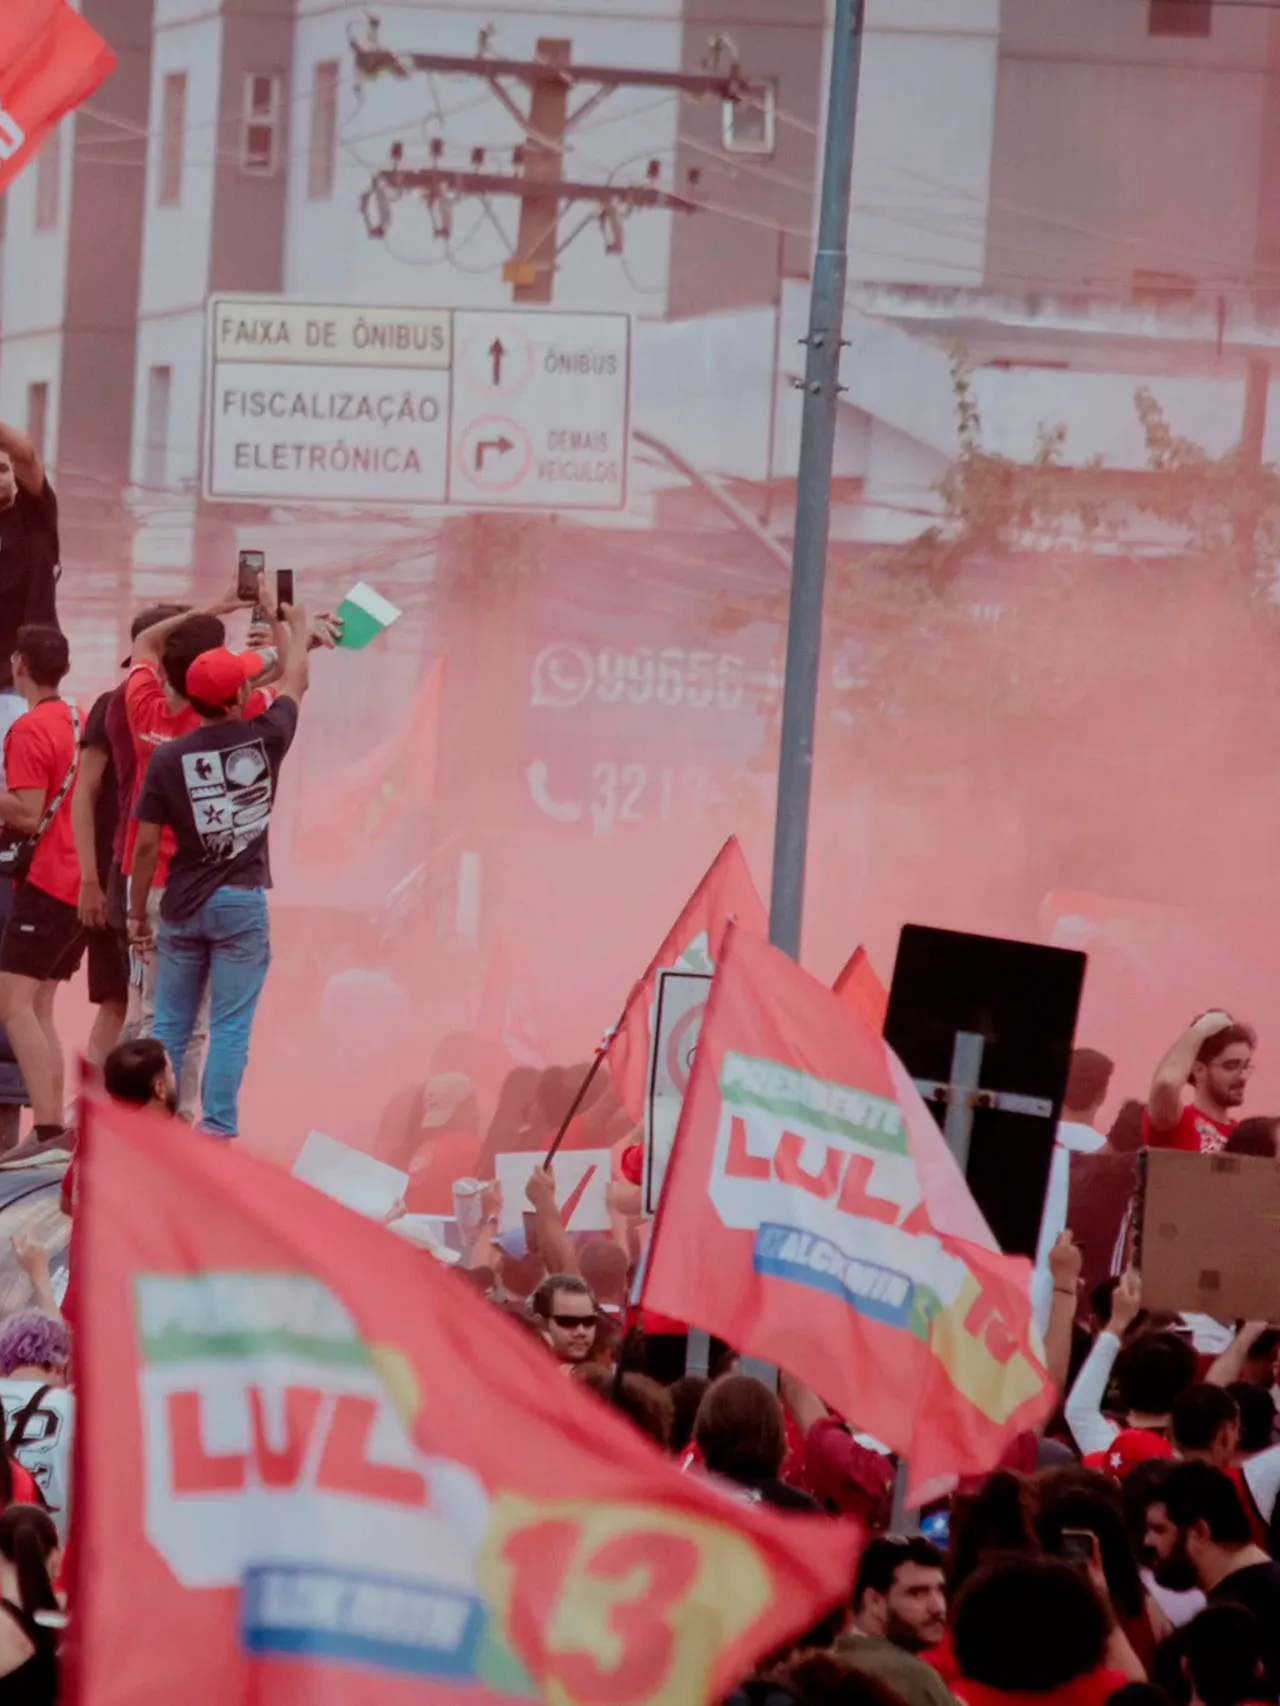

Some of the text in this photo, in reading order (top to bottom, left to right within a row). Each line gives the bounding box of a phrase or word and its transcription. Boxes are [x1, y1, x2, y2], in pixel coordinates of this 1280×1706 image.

[221, 315, 445, 350] FAIXA DE ÔNIBUS
[544, 348, 618, 376] ÔNIBUS
[222, 390, 440, 427] FISCALIZAÇÃO
[233, 440, 422, 473] ELETRÔNICA
[502, 1519, 701, 1704] 13
